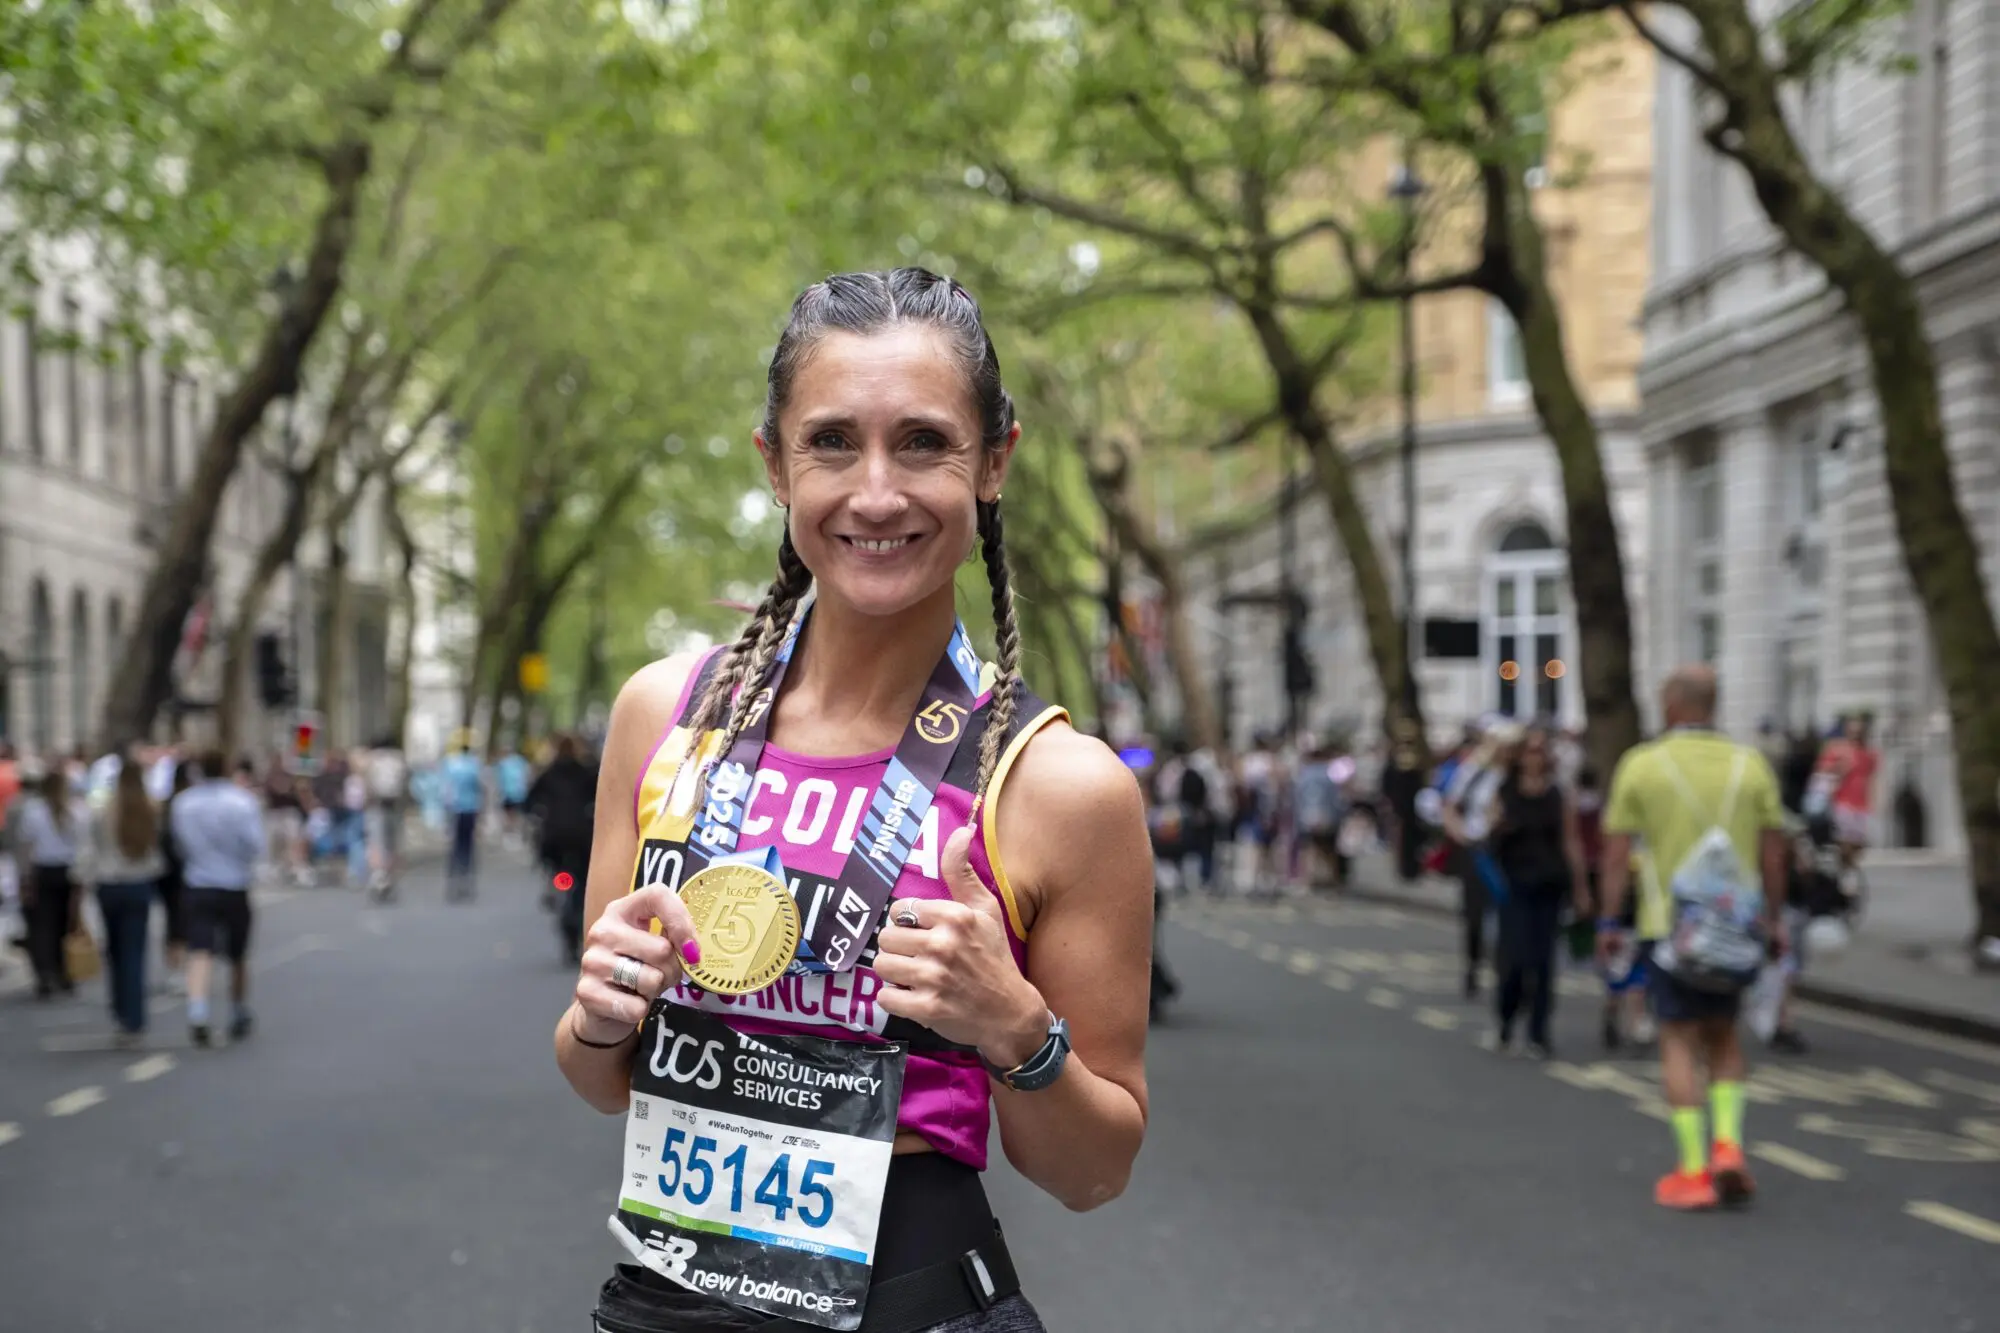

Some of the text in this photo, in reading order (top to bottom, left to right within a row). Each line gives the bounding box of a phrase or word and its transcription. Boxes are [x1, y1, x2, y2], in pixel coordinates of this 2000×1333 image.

[915, 699, 968, 744] 45
[656, 752, 940, 880] NCOLA
[700, 762, 746, 846] 2025
[869, 780, 919, 862] FINISHER
[643, 847, 684, 894] YO
[712, 966, 884, 1027] ANCER
[649, 1013, 725, 1090] tcs
[733, 1054, 882, 1096] CONSULTANCY
[733, 1078, 822, 1110] SERVICES
[636, 1143, 651, 1153] WAVE
[708, 1119, 773, 1141] #WeRunTogether
[658, 1127, 835, 1228] 55145
[691, 1268, 833, 1313] new balance
